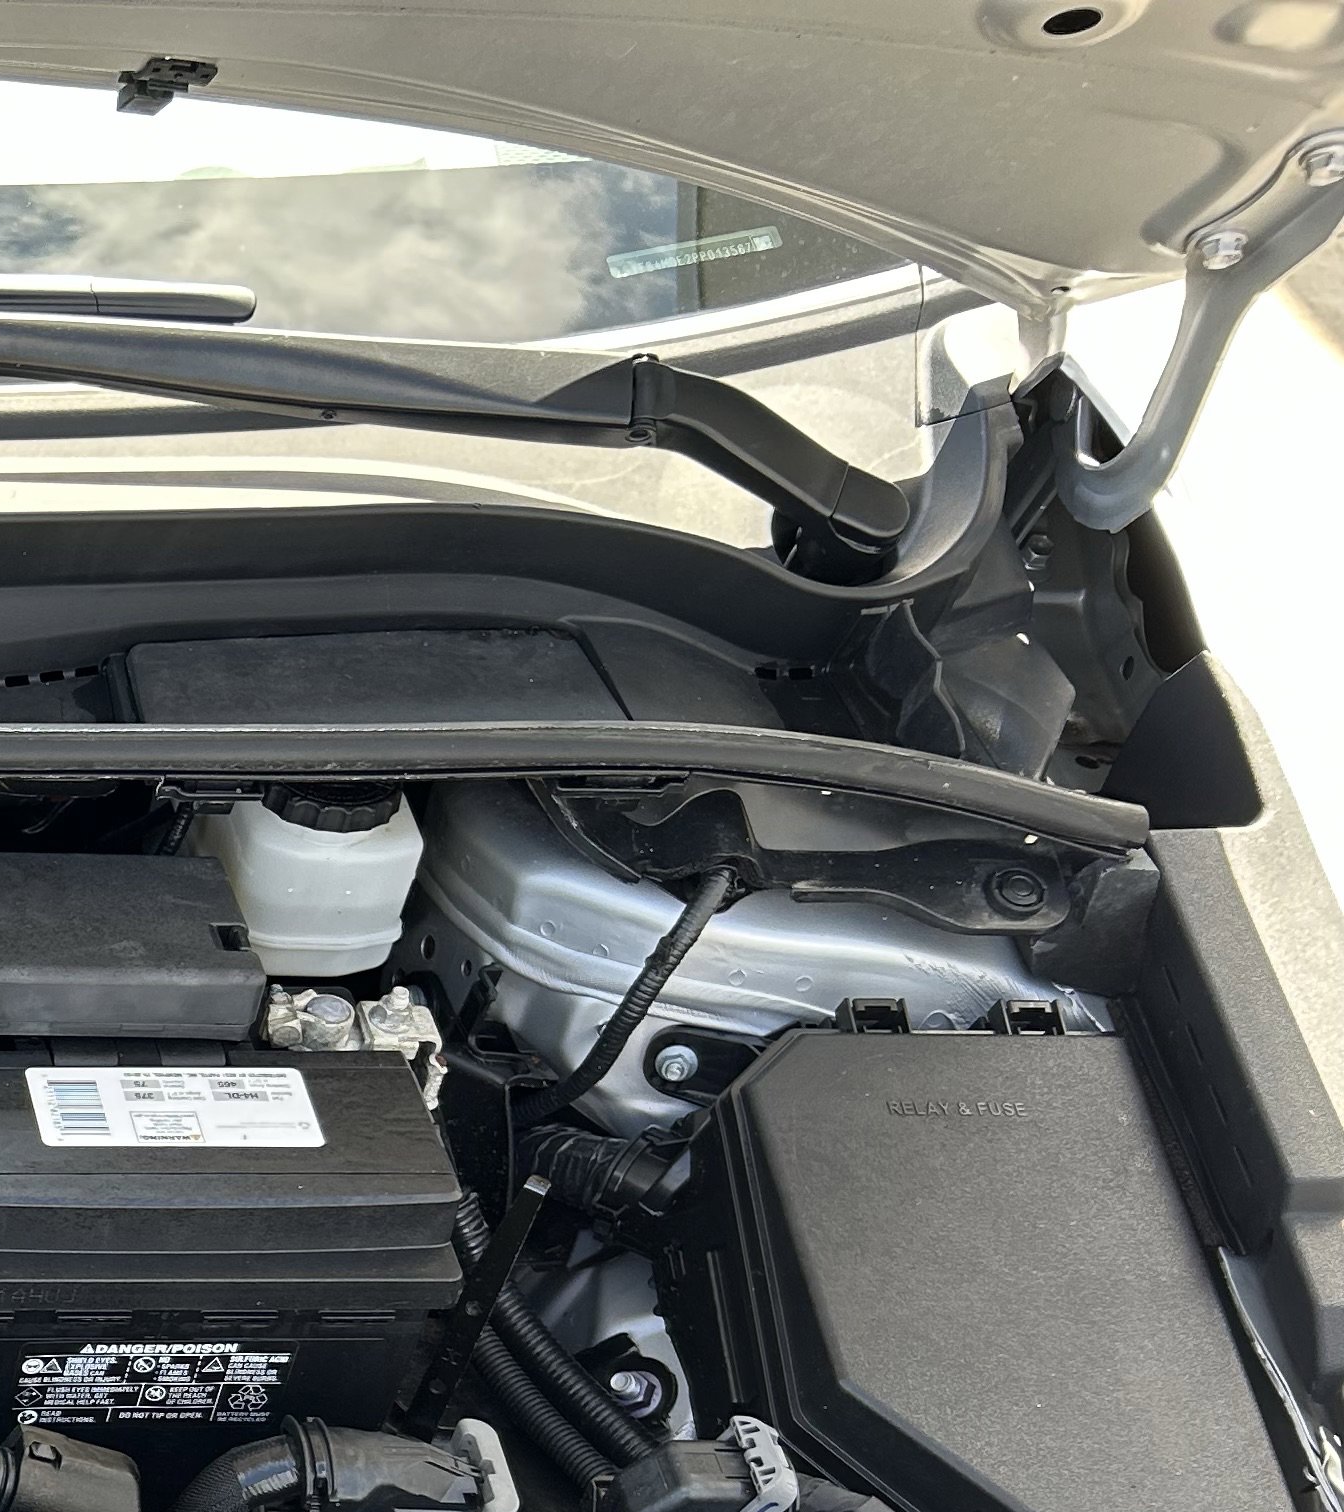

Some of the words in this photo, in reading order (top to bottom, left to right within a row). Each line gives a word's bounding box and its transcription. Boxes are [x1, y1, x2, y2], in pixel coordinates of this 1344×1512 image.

[887, 1101, 951, 1117] RELAY
[958, 1102, 974, 1117] &
[978, 1102, 1028, 1117] FUSE
[95, 1343, 239, 1354] DANGER/POISON
